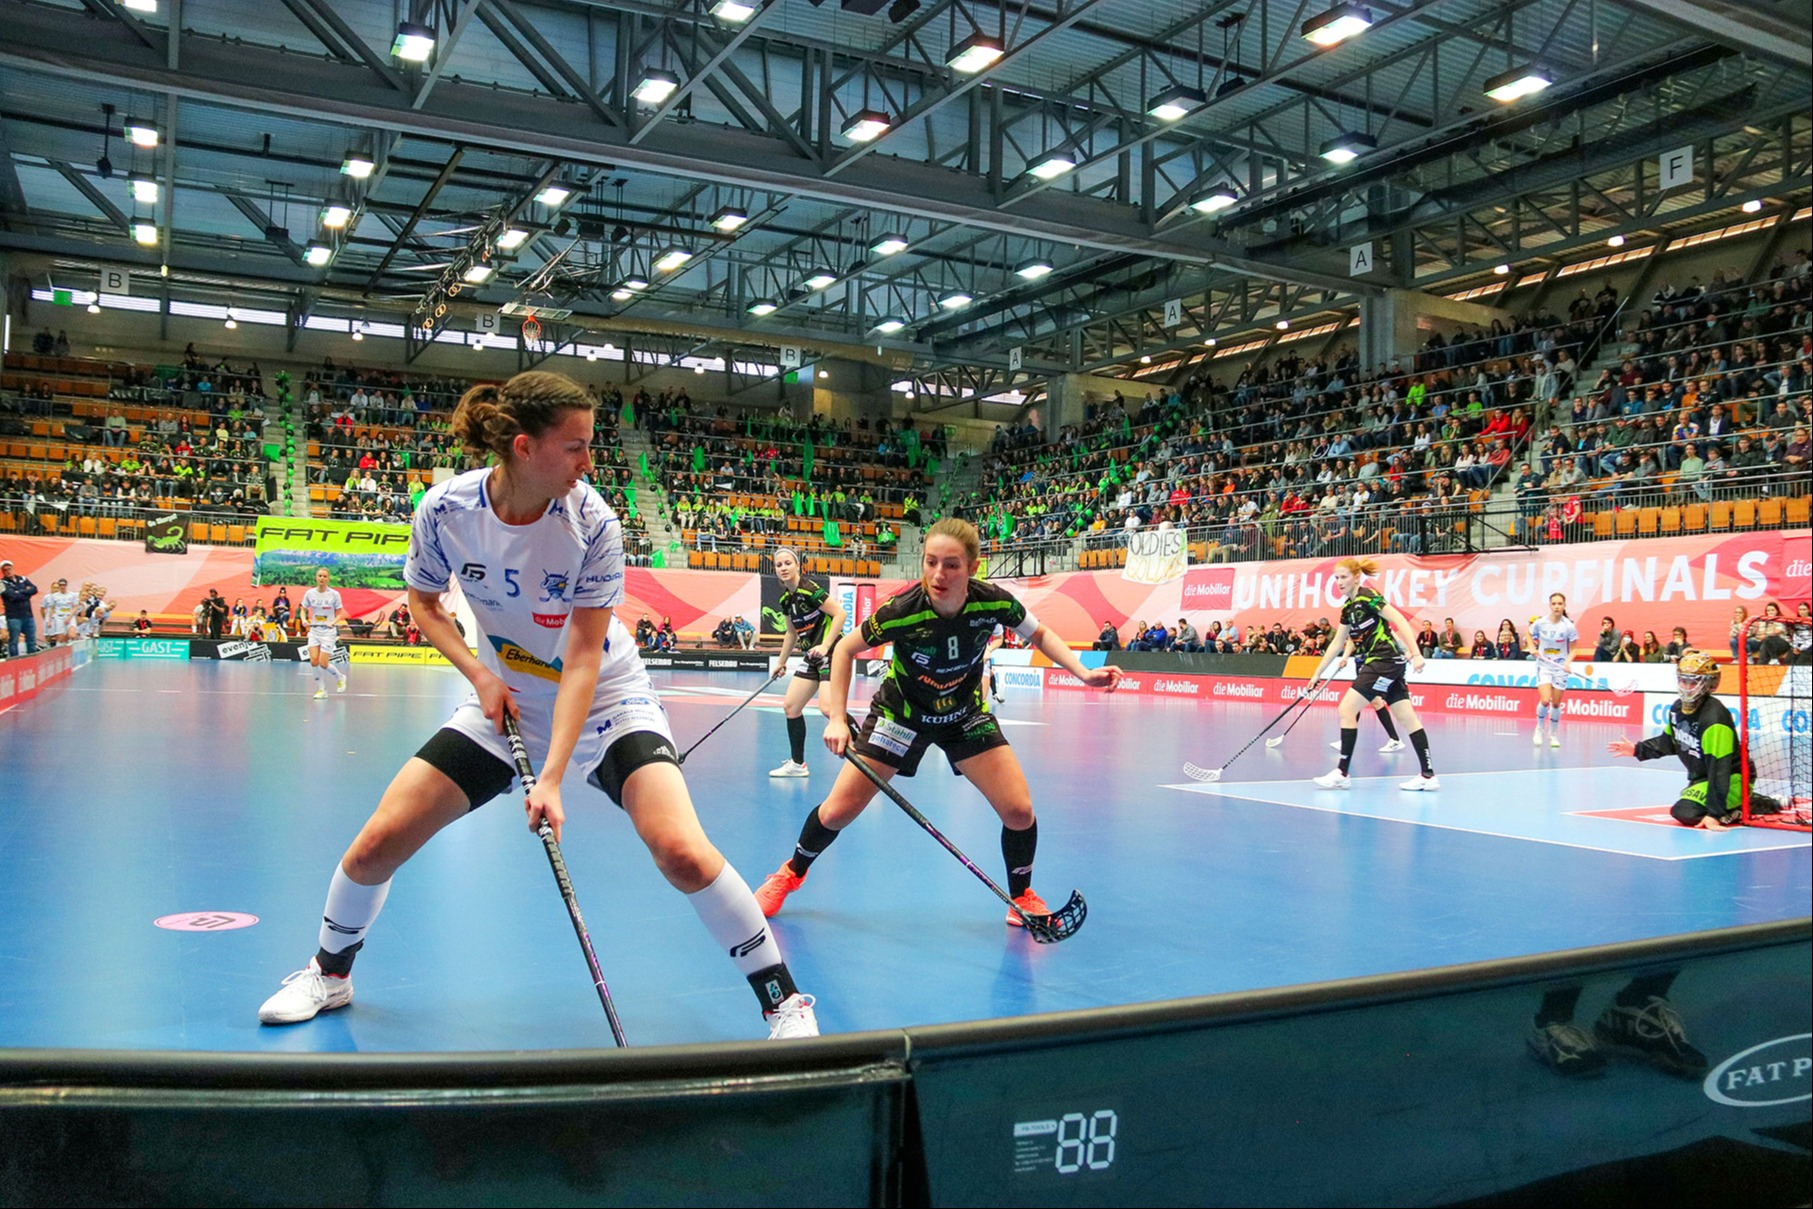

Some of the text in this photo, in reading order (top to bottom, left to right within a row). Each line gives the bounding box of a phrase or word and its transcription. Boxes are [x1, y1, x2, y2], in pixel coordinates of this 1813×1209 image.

[1669, 155, 1684, 180] F
[1354, 249, 1368, 268] A
[107, 272, 122, 288] B
[481, 314, 494, 329] B
[1167, 304, 1177, 321] A
[785, 349, 796, 361] B
[1011, 351, 1020, 367] A
[260, 527, 412, 546] FAT PIP
[1129, 531, 1181, 557] OLDIES
[504, 568, 521, 598] 5
[1235, 550, 1769, 610] UNIHOKEY CUPFINALS
[1184, 583, 1231, 597] die Mobiliar
[141, 641, 172, 654] GAST
[947, 635, 959, 660] 8
[1004, 669, 1041, 687] CONCORDIA
[1153, 680, 1199, 694] die Mobiliar
[1213, 682, 1264, 698] die Mobiliar
[1281, 685, 1295, 699] die
[1446, 693, 1520, 712] die Mobiliar
[1566, 698, 1630, 718] Mobiliar
[1726, 1060, 1786, 1091] FAT
